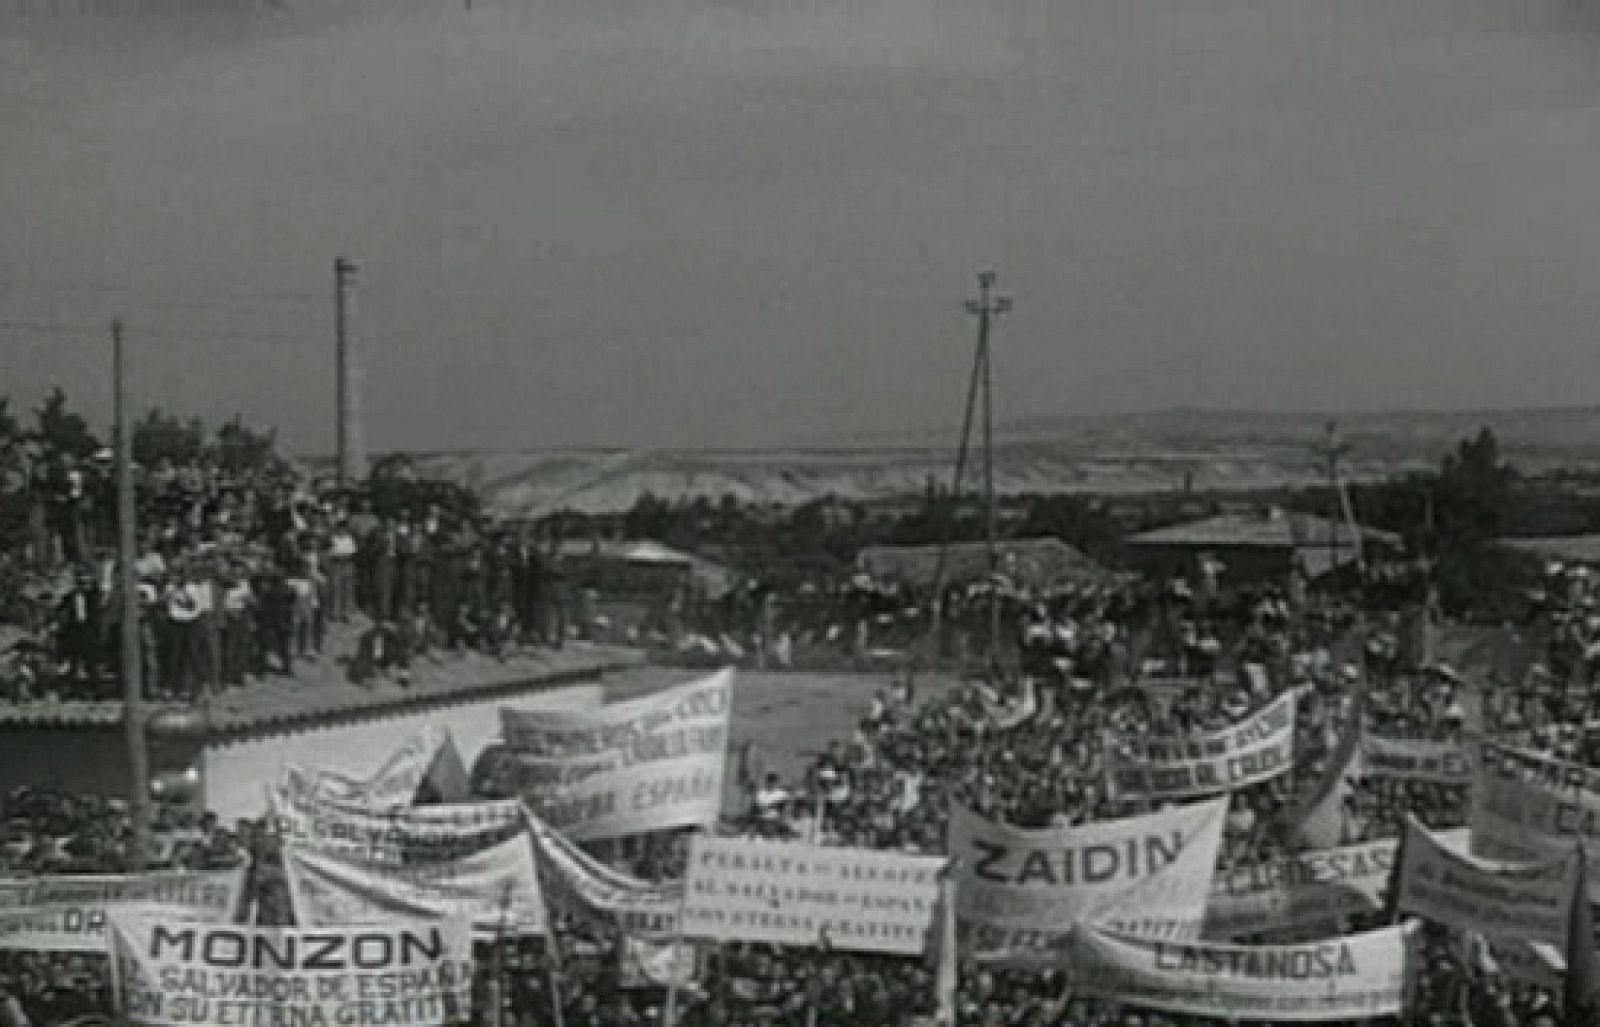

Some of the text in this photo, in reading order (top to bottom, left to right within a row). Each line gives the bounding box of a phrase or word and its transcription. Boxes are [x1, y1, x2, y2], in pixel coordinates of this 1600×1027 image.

[971, 830, 1184, 887] ZAIDIN
[148, 924, 445, 971] MONZON
[160, 967, 310, 1002] SALVADOR
[316, 974, 352, 1000] DE
[170, 997, 209, 1023] SU
[217, 997, 326, 1027] ETERNA
